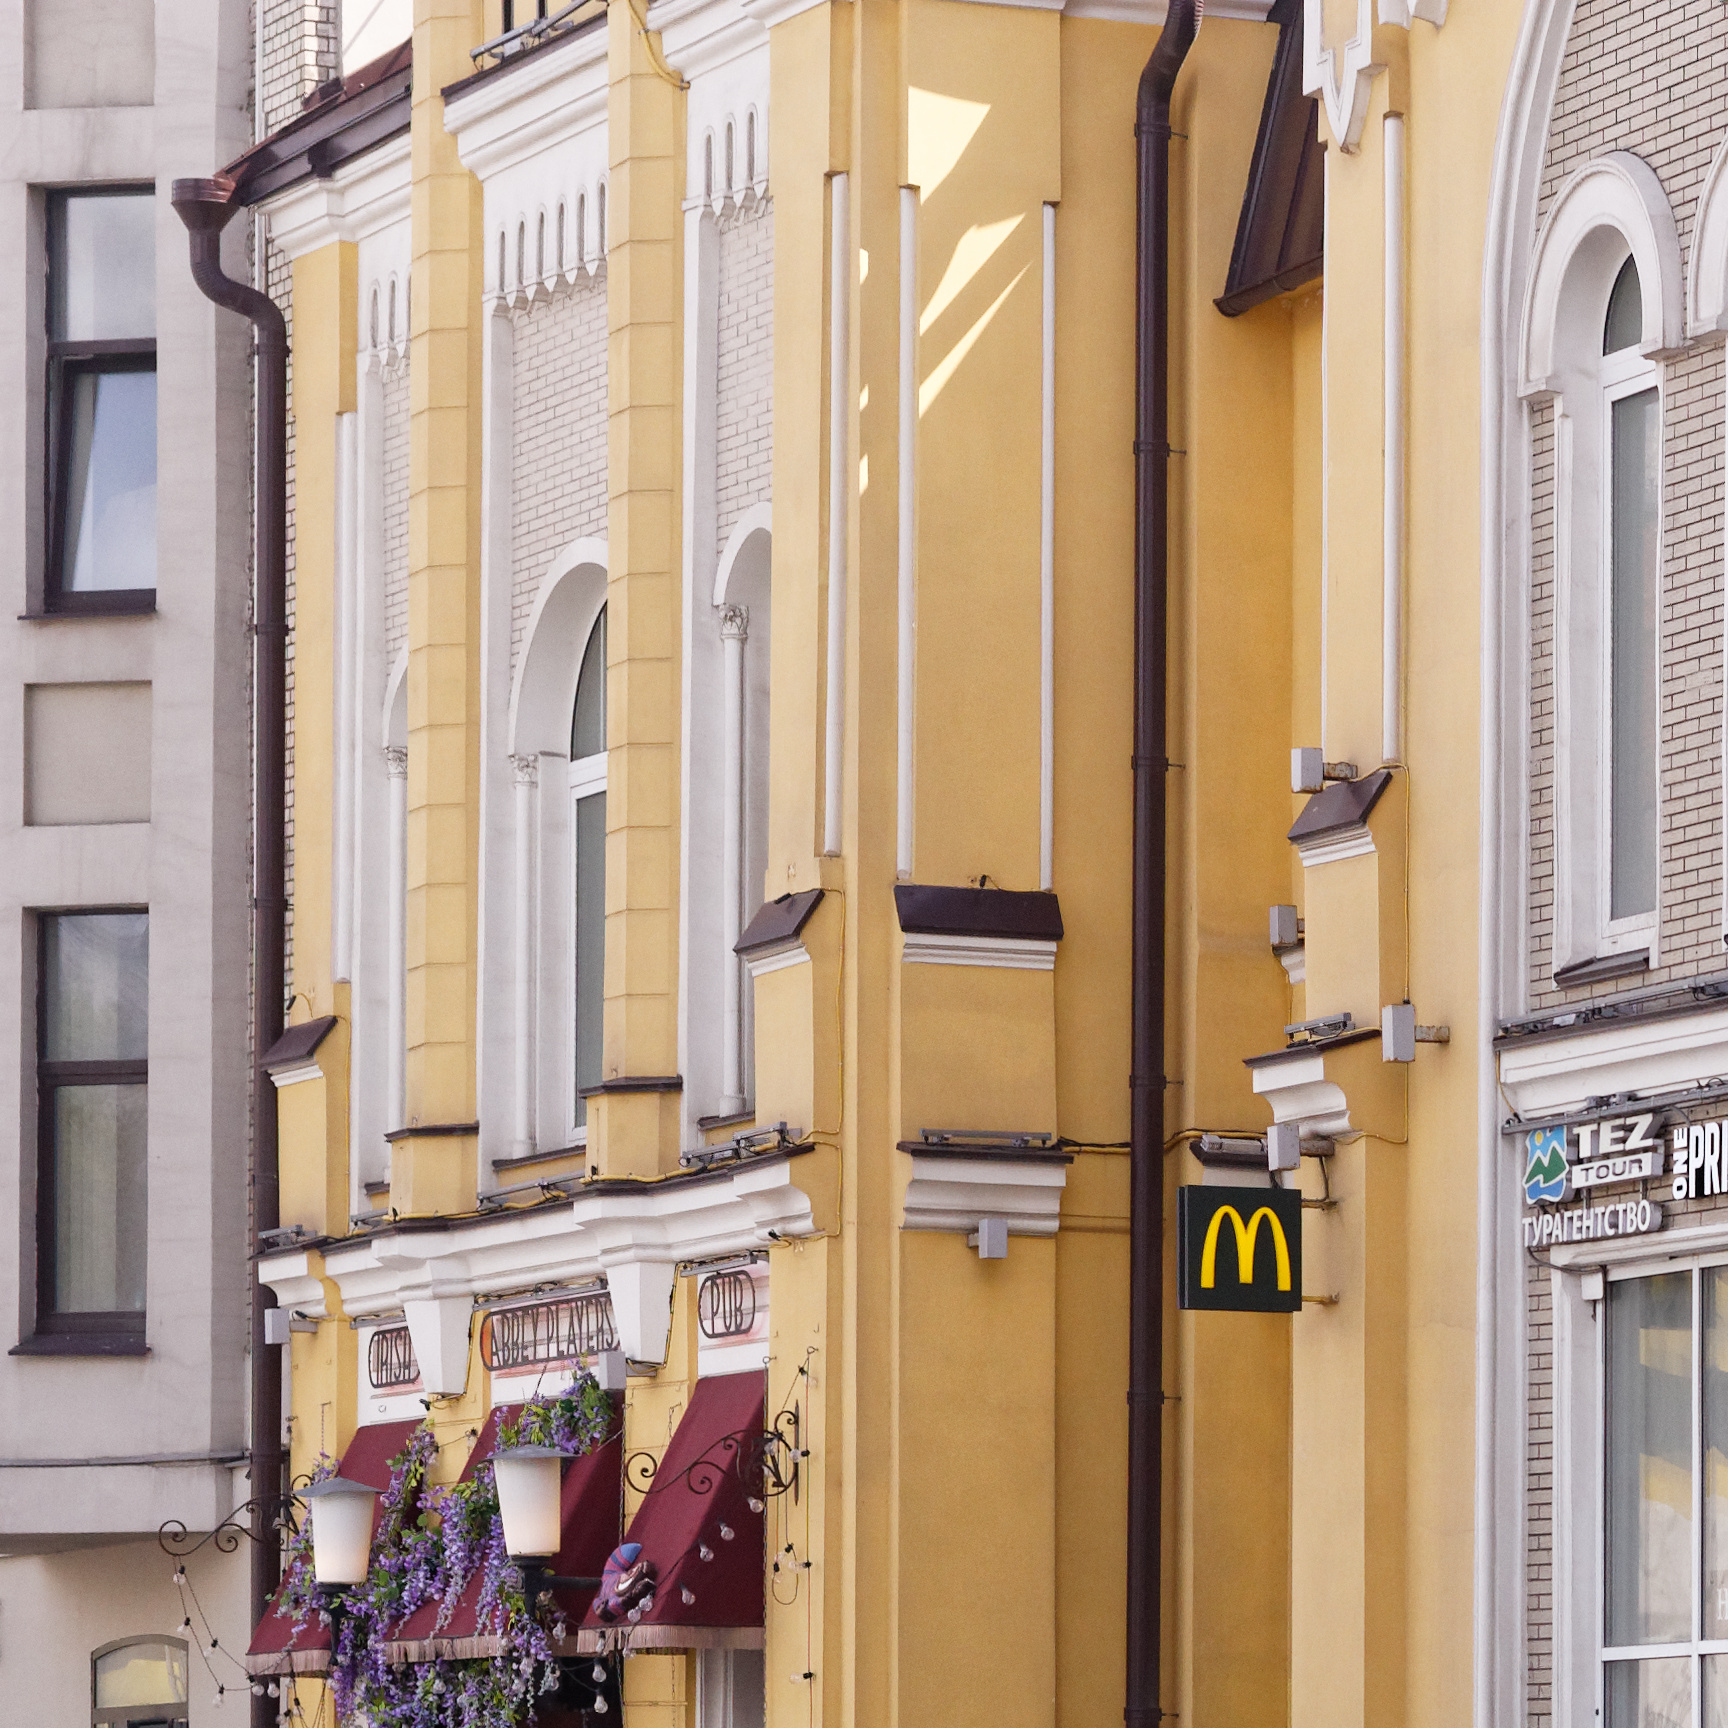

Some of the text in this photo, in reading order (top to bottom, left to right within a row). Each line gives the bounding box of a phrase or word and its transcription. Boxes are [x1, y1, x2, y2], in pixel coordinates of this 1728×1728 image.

[1572, 1113, 1654, 1159] TEZ
[1672, 1126, 1688, 1200] ONE
[1580, 1158, 1643, 1183] TOUR
[1522, 1199, 1651, 1247] ТУРАГЕНТСТВО
[711, 1273, 744, 1334] PUB
[376, 1329, 412, 1384] IRISH
[491, 1298, 614, 1368] ABBEY PLAYERS
